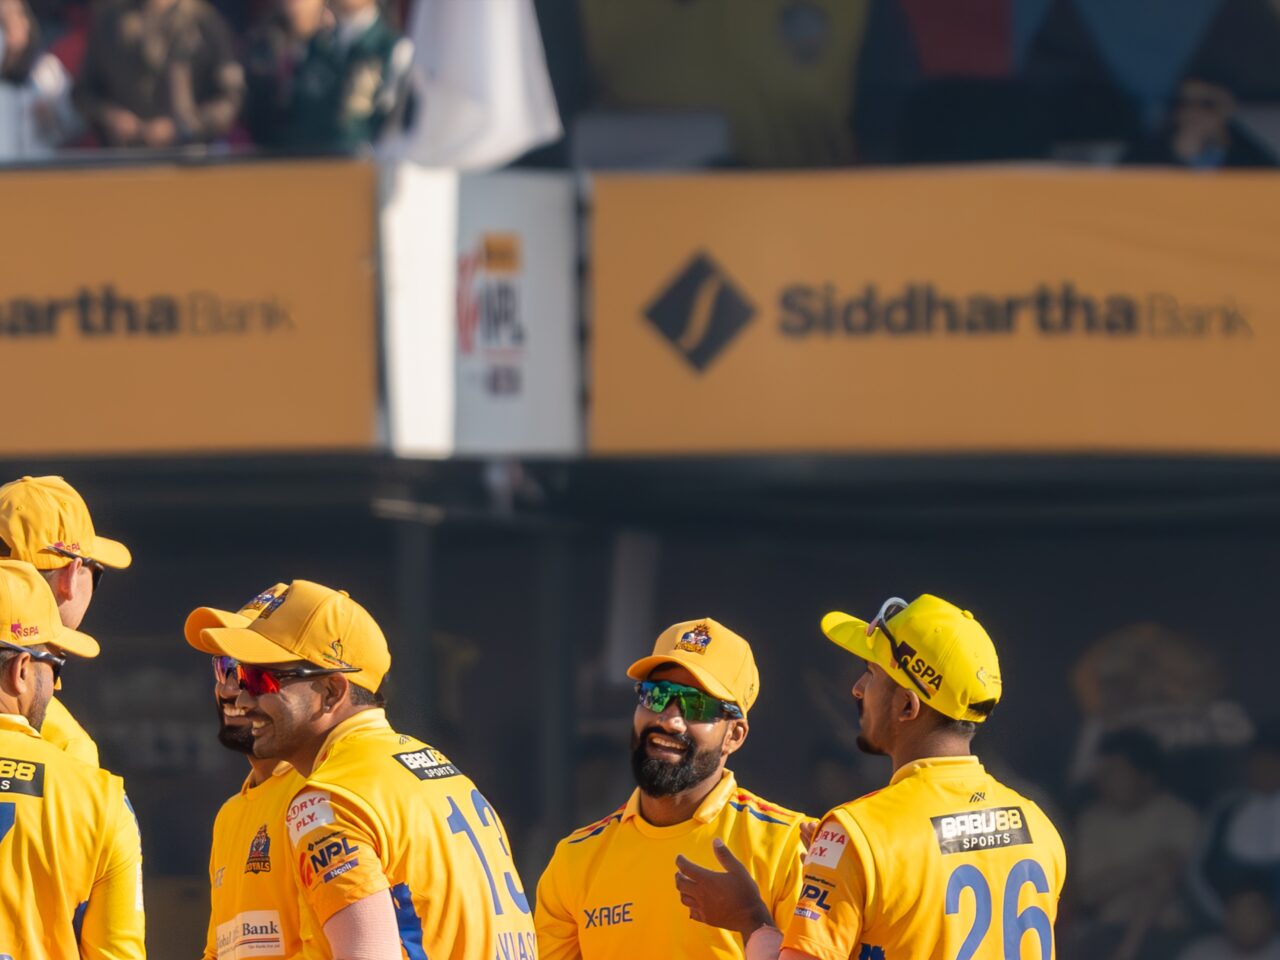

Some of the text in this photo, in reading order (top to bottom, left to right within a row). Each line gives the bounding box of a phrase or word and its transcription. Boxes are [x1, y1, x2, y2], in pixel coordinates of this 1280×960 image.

[776, 279, 1140, 340] Siddhartha
[911, 658, 944, 691] SPA
[424, 765, 456, 778] SPORTS
[940, 808, 1023, 839] BABU88
[310, 837, 360, 875] NPL
[962, 832, 1011, 850] SPORTS
[242, 920, 279, 936] Bank
